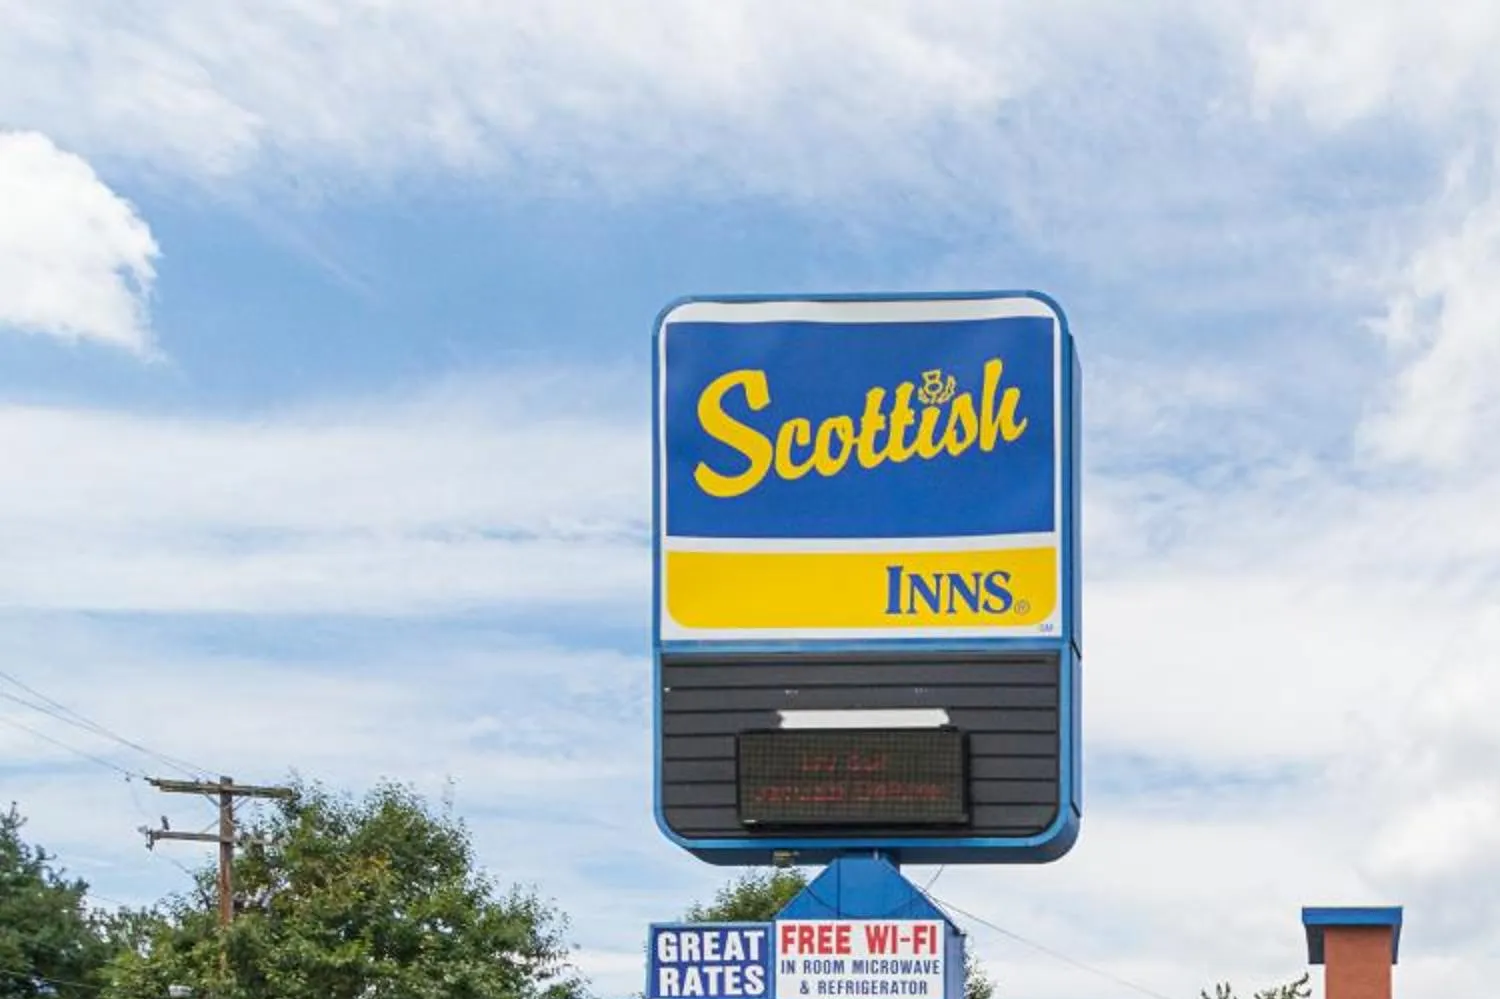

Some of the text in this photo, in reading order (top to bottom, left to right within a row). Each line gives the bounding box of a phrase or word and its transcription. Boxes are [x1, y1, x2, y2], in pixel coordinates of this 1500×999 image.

[694, 358, 1028, 498] Scottish
[884, 565, 1013, 615] INNS
[657, 931, 764, 963] GREAT
[781, 925, 937, 955] FREE WI-FI
[659, 965, 765, 997] RATES
[781, 960, 941, 975] IN ROOM MICROWAVE
[800, 980, 928, 995] & REFRIGERATOR
